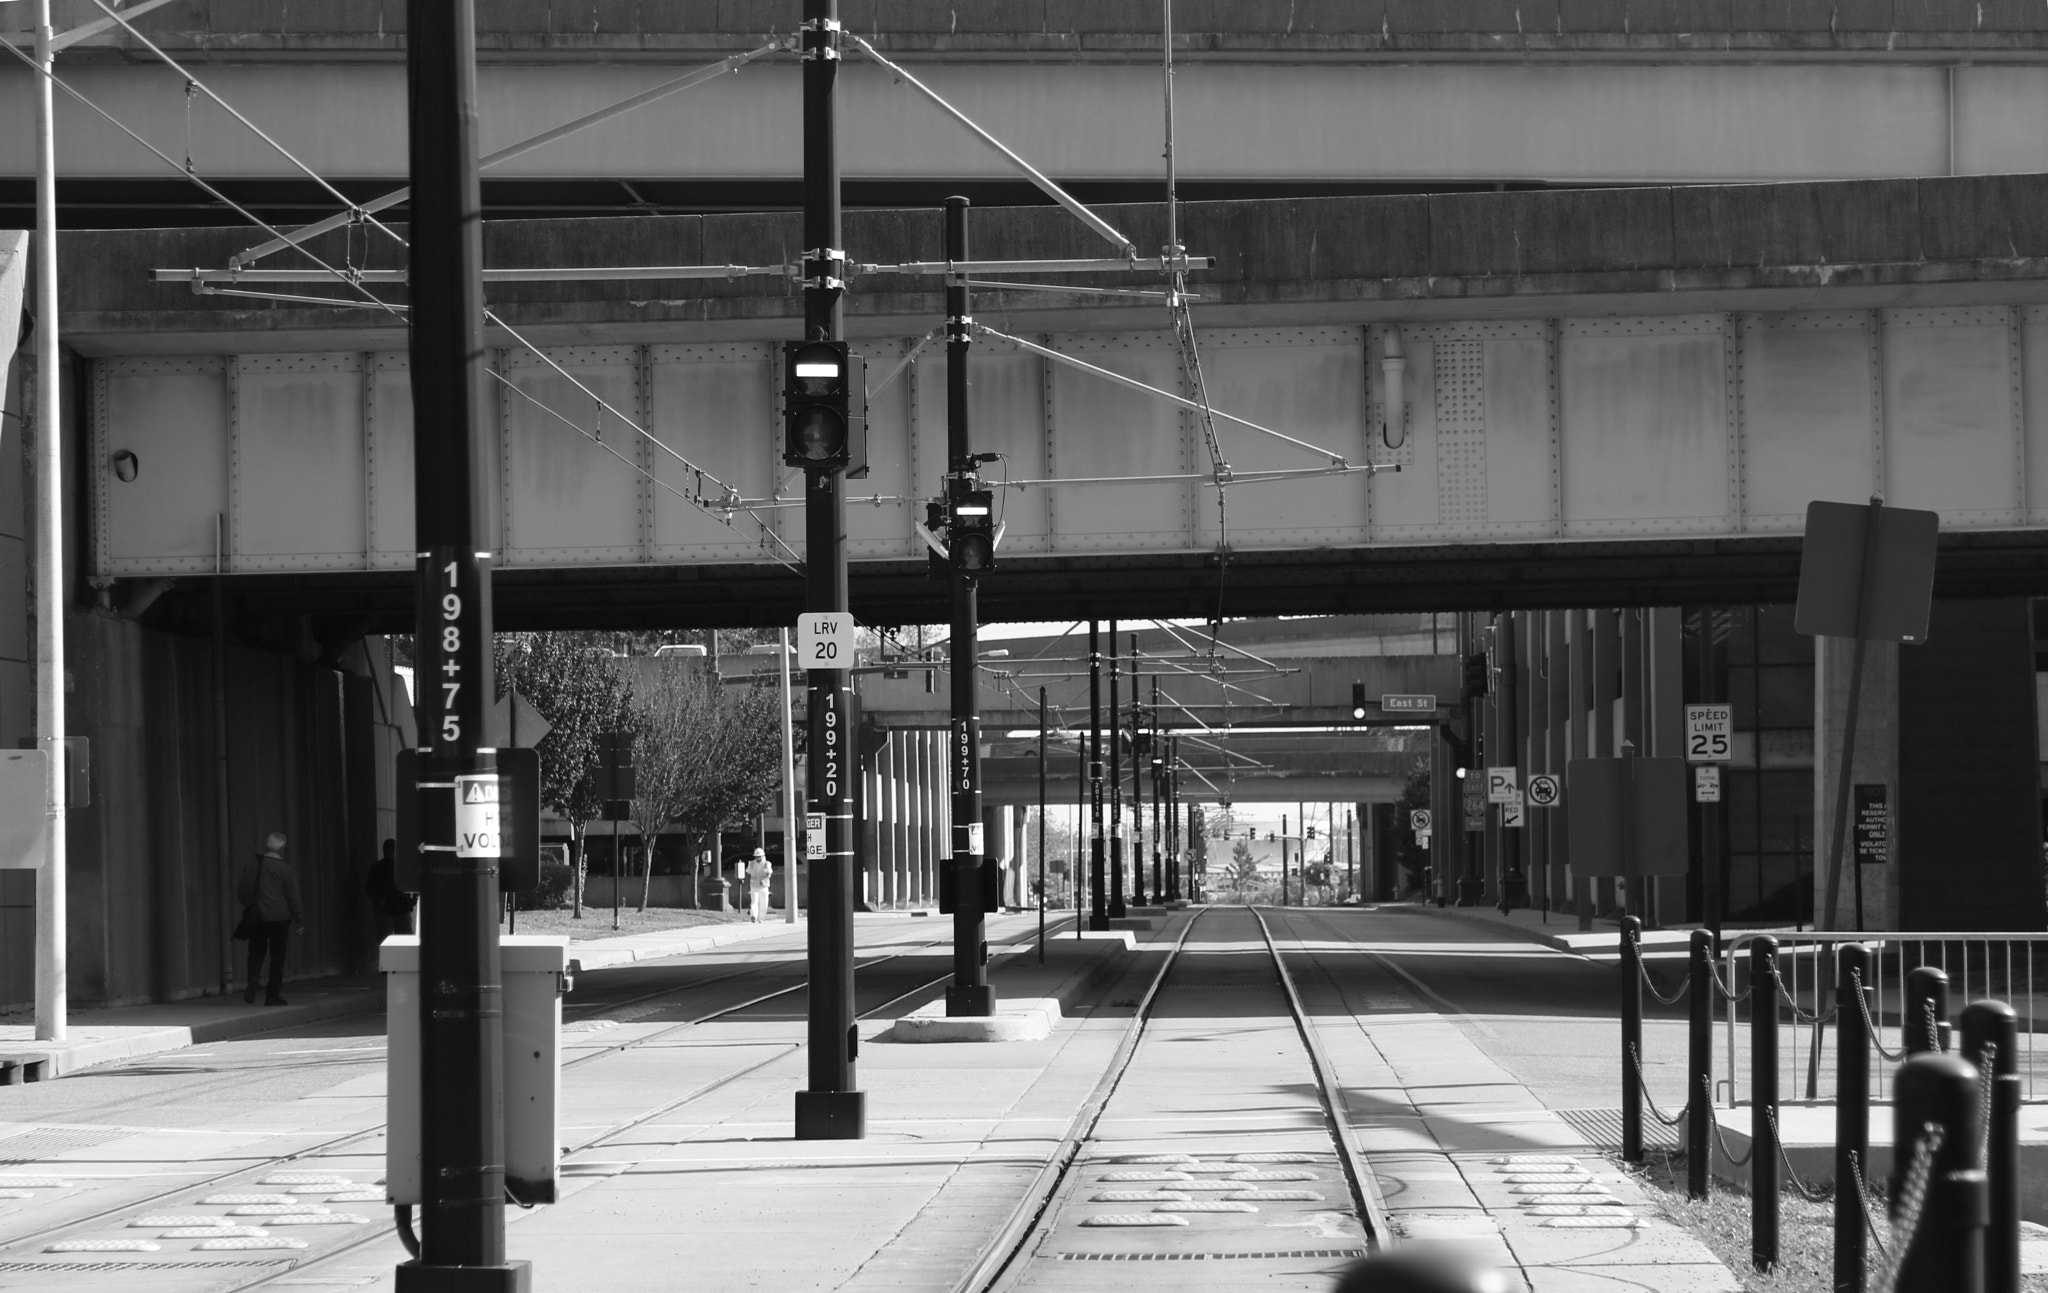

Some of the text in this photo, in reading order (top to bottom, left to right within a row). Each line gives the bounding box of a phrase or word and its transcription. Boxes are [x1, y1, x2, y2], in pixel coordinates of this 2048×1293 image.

[814, 622, 838, 634] LRV
[442, 562, 461, 741] 198+75
[815, 642, 837, 659] 20
[1390, 698, 1428, 708] East St
[1690, 711, 1728, 720] SPEED
[1694, 722, 1724, 732] LIMIT
[825, 693, 837, 796] 199+20
[1691, 735, 1728, 754] 25
[961, 721, 970, 790] 199+70
[1490, 776, 1505, 794] P
[1466, 799, 1484, 811] 264
